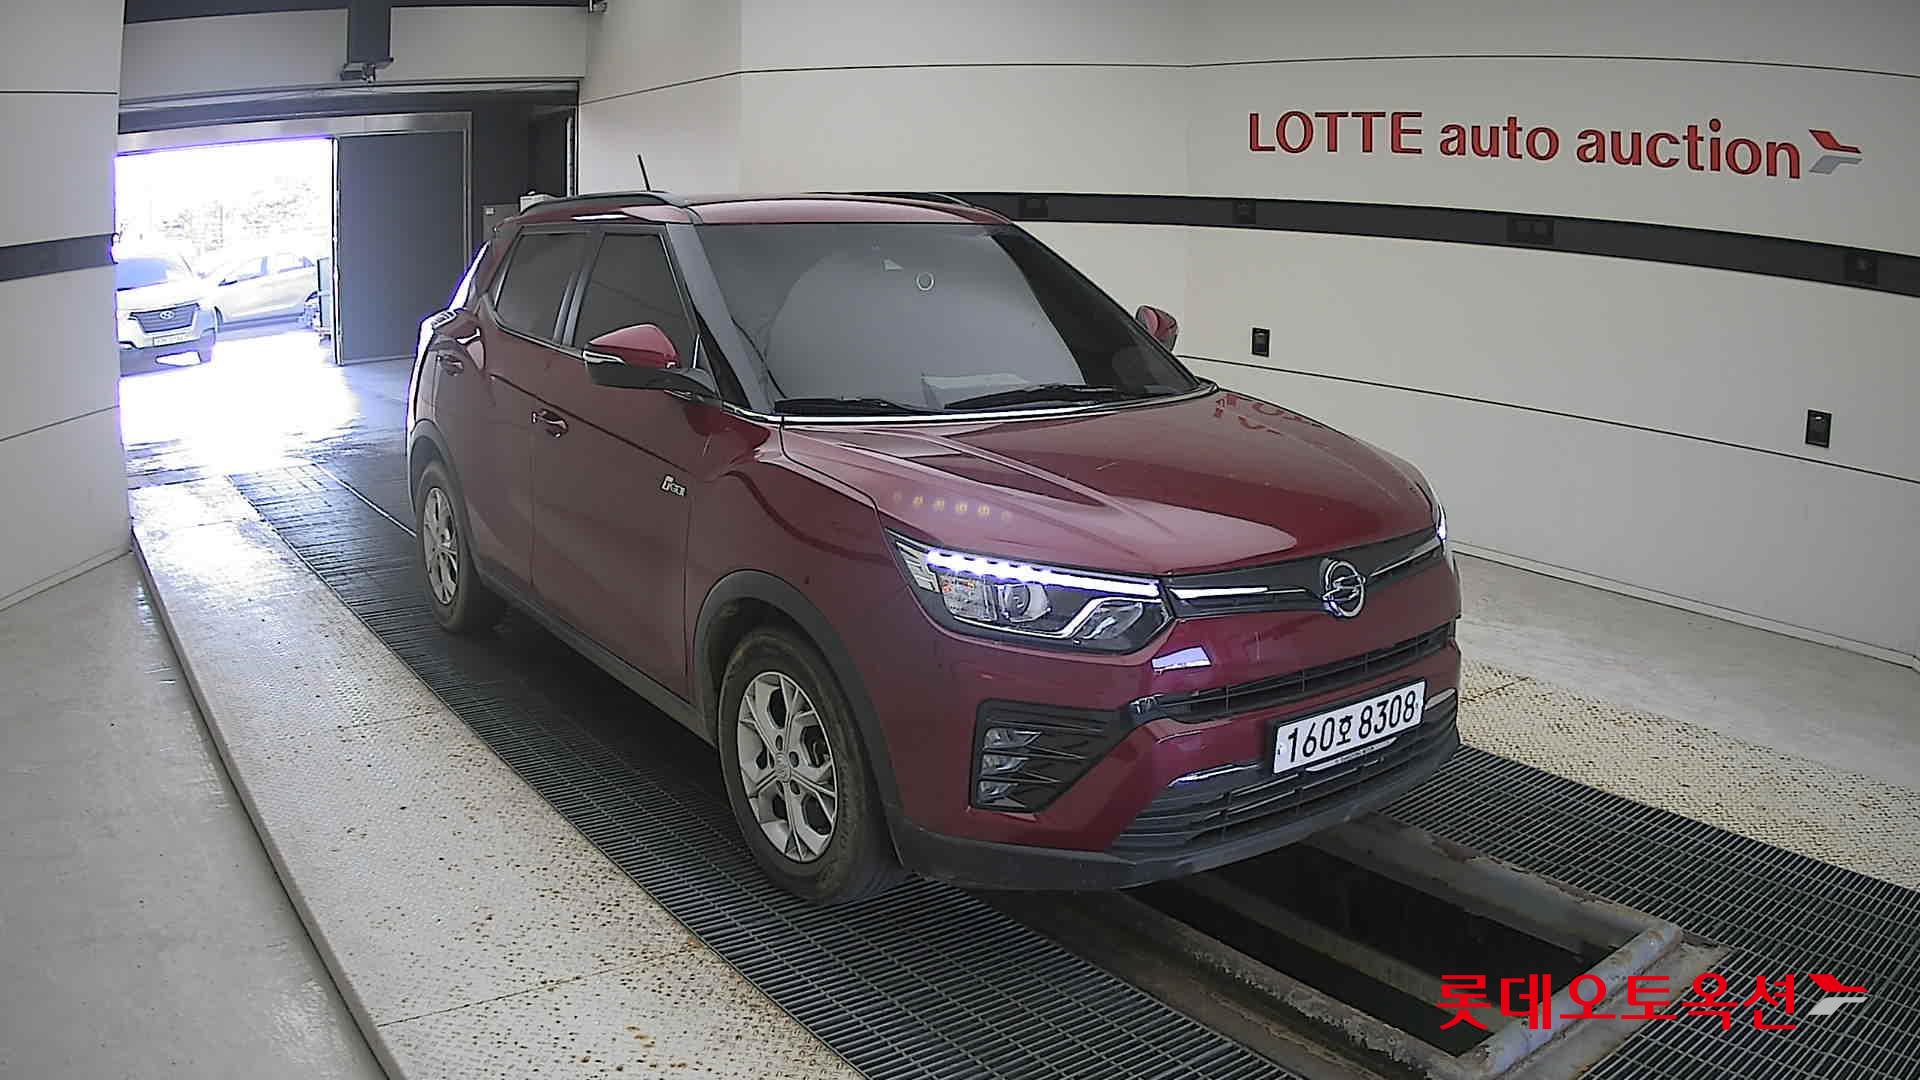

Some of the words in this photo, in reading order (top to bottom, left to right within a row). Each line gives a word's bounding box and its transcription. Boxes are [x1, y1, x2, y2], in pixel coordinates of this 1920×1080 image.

[1249, 111, 1423, 154] LOTTE
[1439, 116, 1560, 160] auto
[1576, 118, 1801, 179] auction
[1288, 714, 1353, 763] 160호
[1358, 690, 1416, 739] 8308
